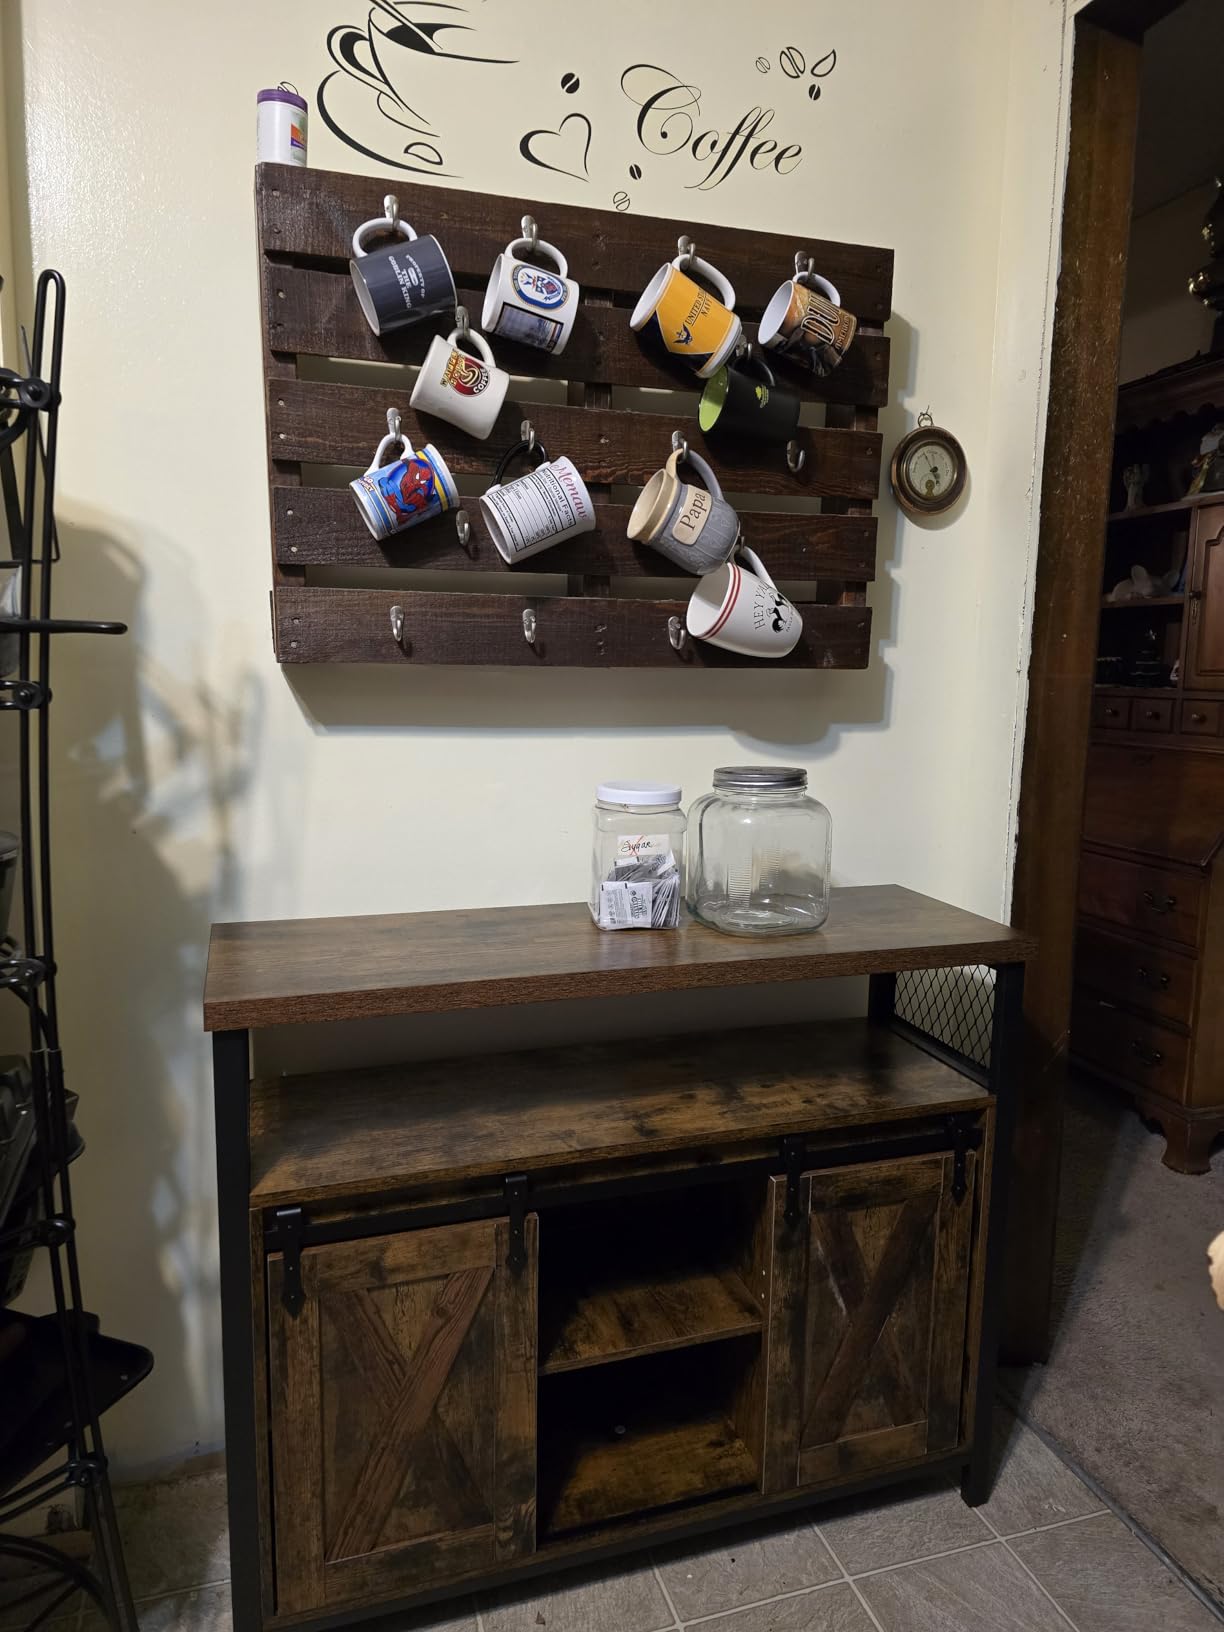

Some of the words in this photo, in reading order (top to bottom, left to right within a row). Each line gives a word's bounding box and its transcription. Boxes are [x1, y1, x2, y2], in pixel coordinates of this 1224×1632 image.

[620, 63, 803, 191] Coffee
[388, 255, 406, 285] GOBLIN
[401, 286, 412, 309] KING
[401, 268, 412, 289] THE
[405, 254, 425, 287] PROPERTY
[684, 299, 702, 325] UNITED
[541, 468, 566, 502] Nutritional
[560, 503, 574, 527] Facts
[549, 464, 588, 520] Memaw
[679, 492, 707, 531] Papa
[753, 601, 767, 630] HEY
